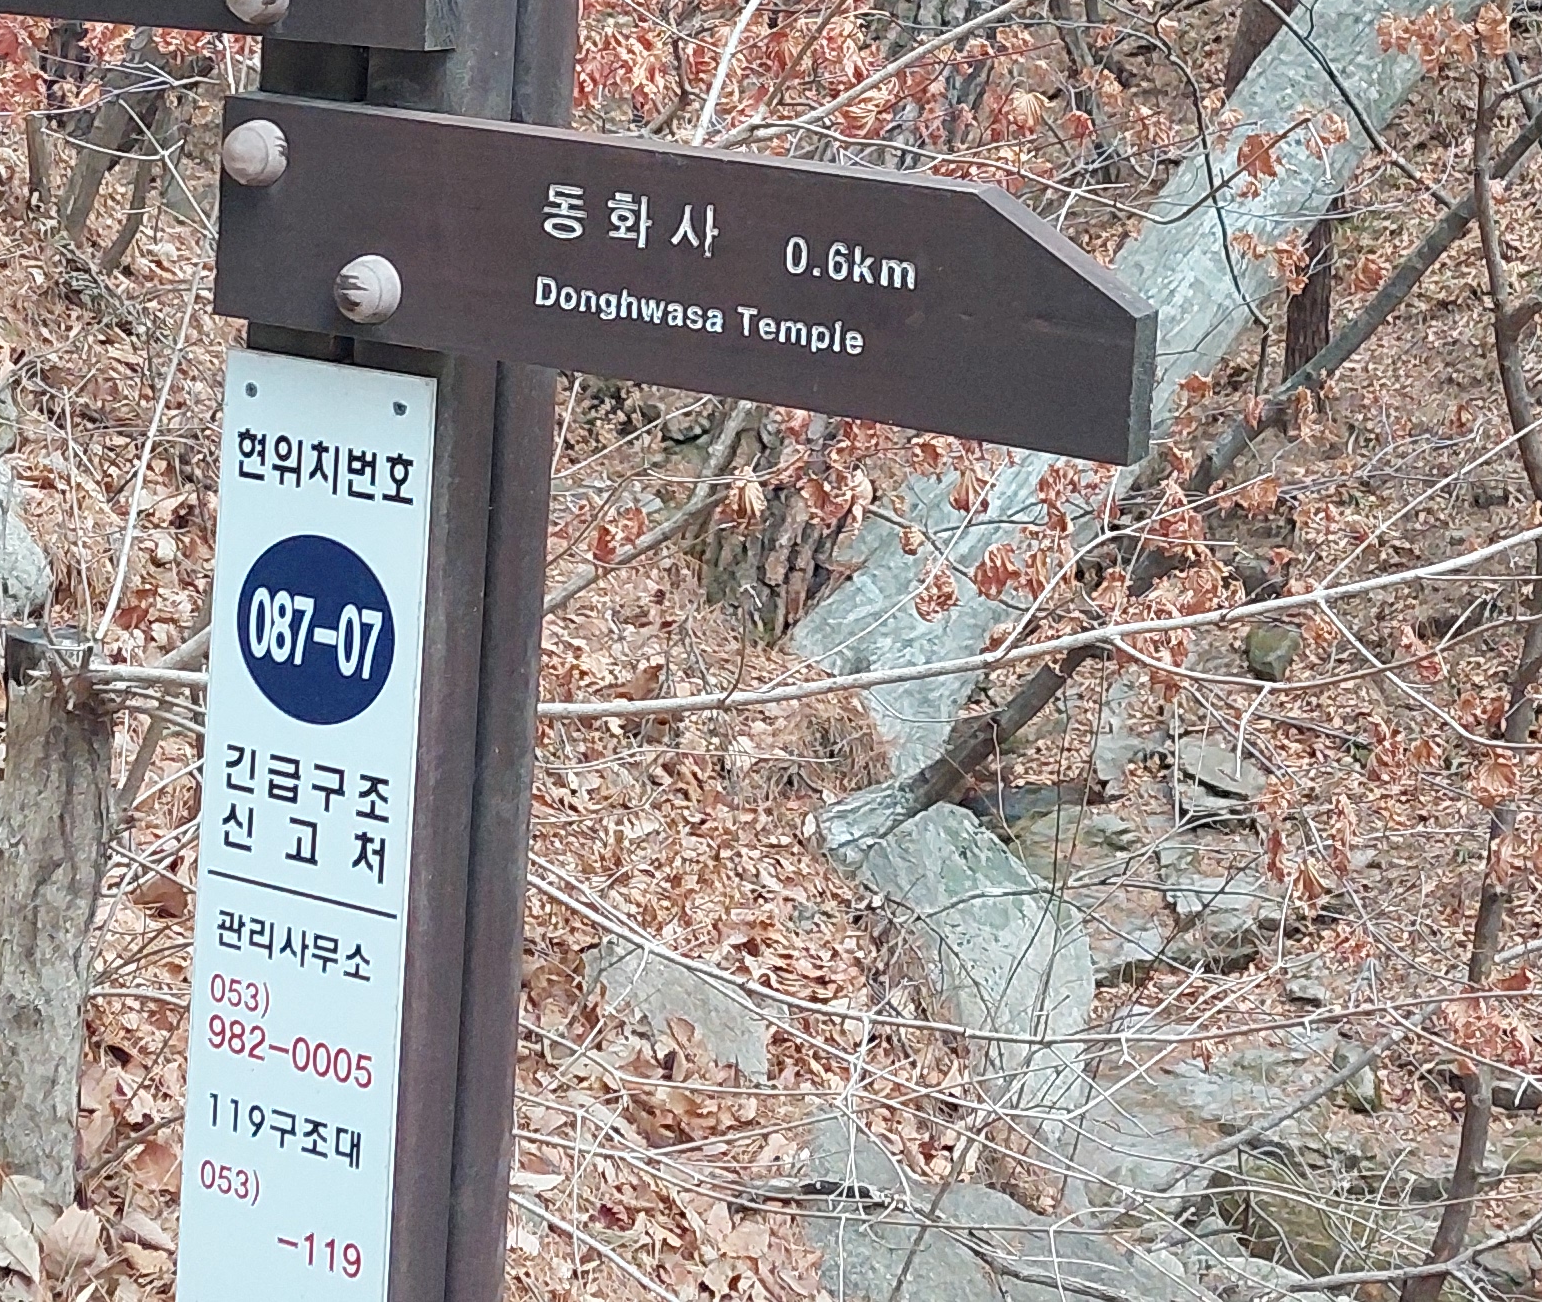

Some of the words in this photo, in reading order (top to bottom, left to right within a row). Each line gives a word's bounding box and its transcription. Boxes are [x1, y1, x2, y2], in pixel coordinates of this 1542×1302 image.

[786, 236, 916, 290] 0.6km
[535, 275, 724, 333] Donghwasa
[737, 305, 864, 355] Temple
[237, 427, 414, 506] 현위치번호
[249, 586, 384, 681] 087-07
[223, 743, 391, 825] 긴급구조
[216, 908, 372, 983] 관리사무소
[209, 973, 271, 1019] 053)
[207, 1013, 374, 1090] 982-0005
[207, 1092, 363, 1170] 119구조대
[200, 1159, 260, 1207] 053)
[277, 1232, 362, 1279] -119
